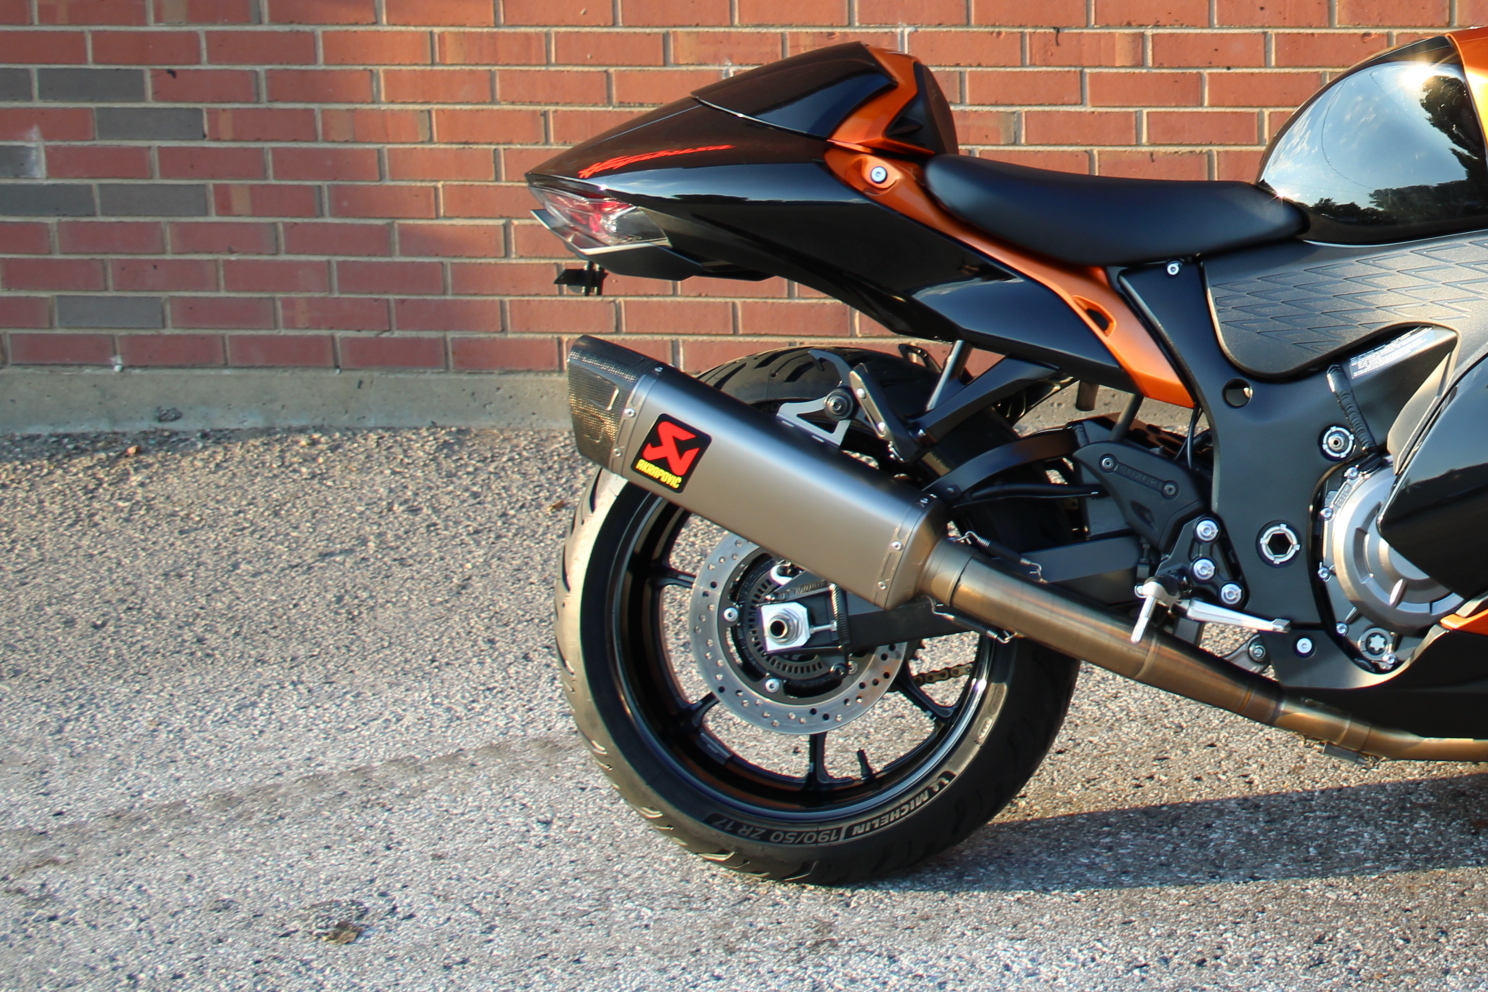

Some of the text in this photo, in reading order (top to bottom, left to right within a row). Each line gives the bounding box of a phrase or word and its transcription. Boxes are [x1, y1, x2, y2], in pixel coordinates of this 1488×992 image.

[852, 790, 929, 836] MICHELIN
[711, 818, 838, 845] 190/50 ZR 17
